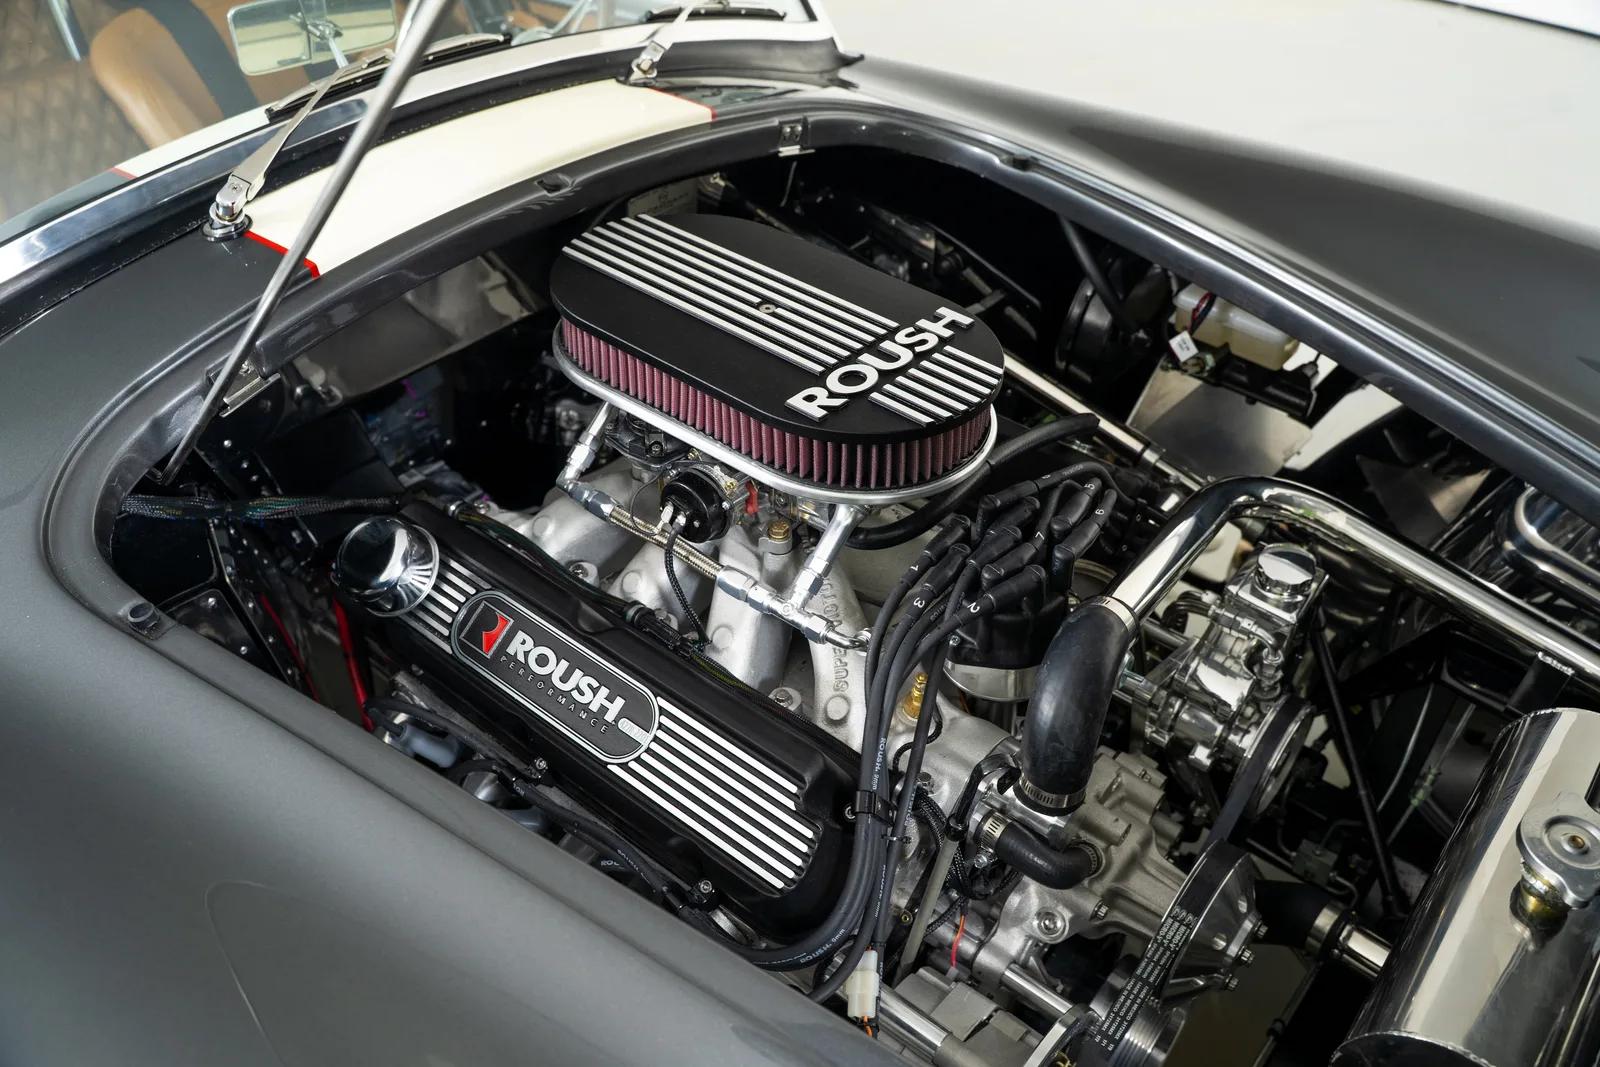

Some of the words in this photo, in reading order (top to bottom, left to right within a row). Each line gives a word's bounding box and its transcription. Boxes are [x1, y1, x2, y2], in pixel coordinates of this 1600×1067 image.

[784, 306, 975, 422] ROUSH
[913, 597, 925, 608] 3
[967, 602, 980, 613] 2
[499, 654, 609, 734] PERFORMANCE
[506, 630, 626, 723] ROUSH
[832, 646, 850, 693] SUPE
